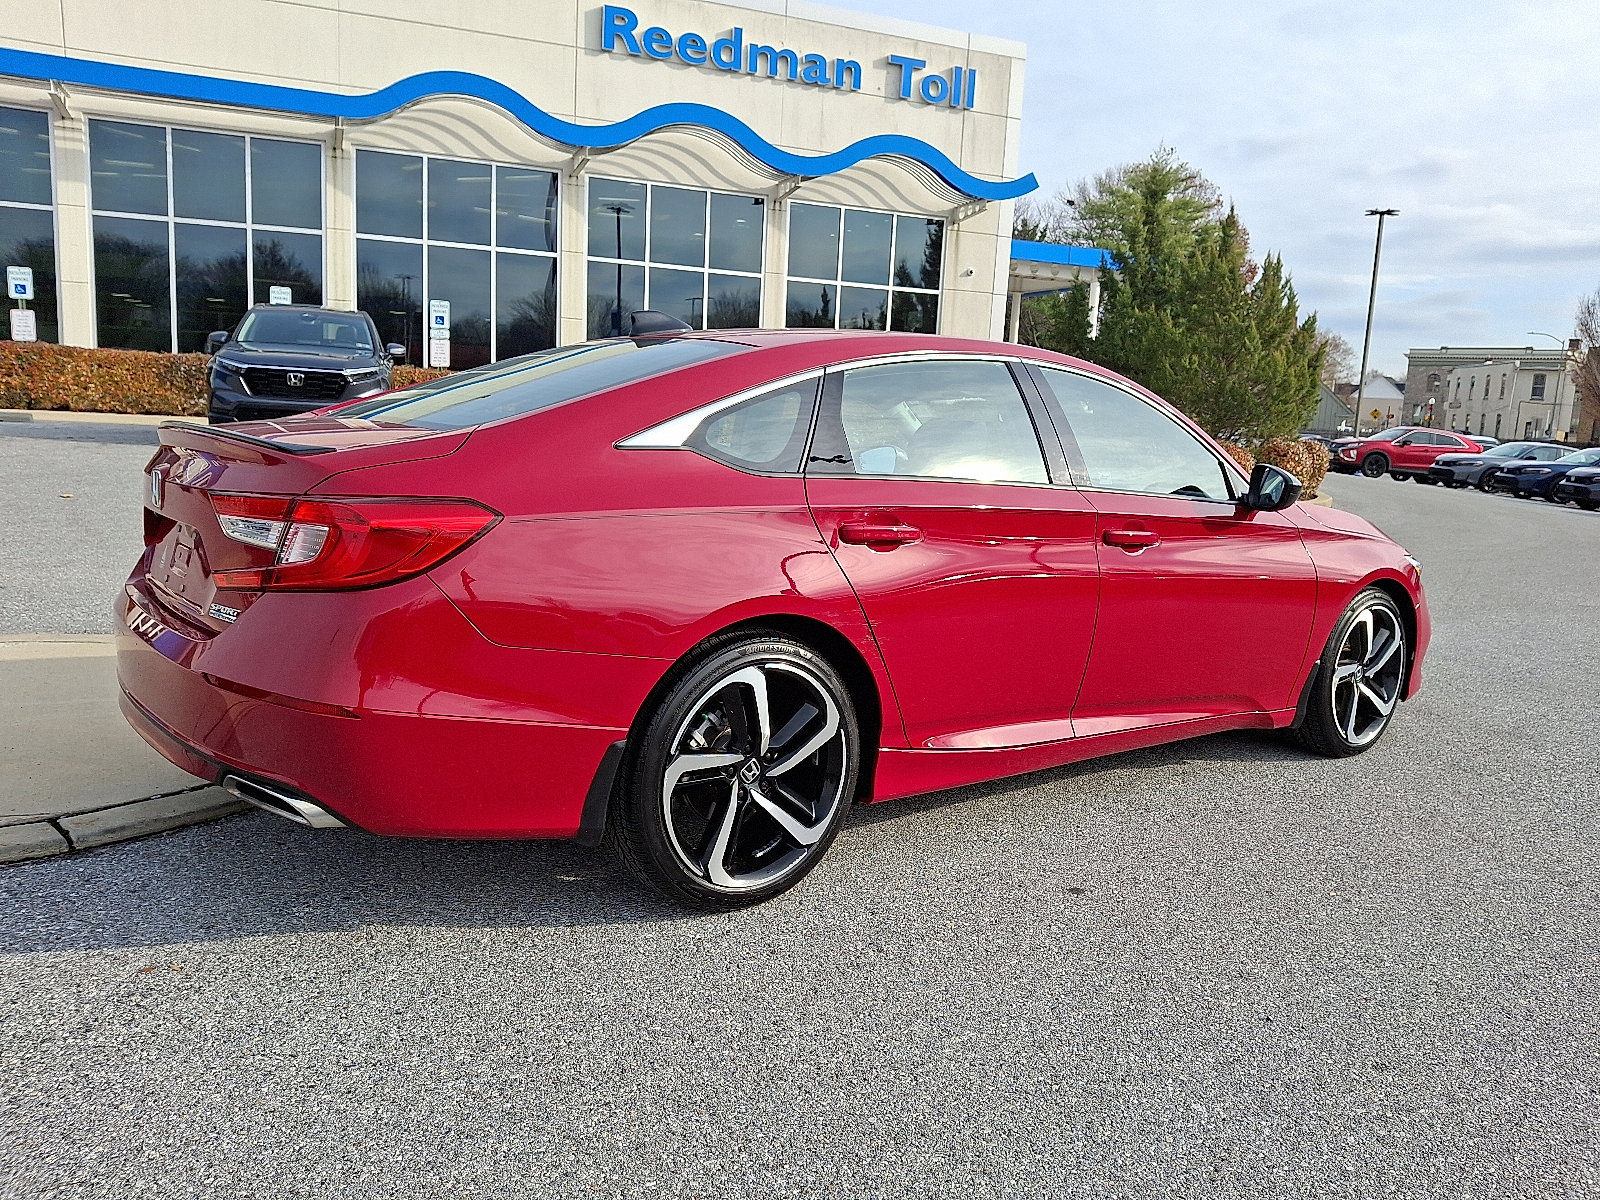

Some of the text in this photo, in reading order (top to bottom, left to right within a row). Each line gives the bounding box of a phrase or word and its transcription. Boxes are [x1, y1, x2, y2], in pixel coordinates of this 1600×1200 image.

[602, 4, 977, 110] Reedman Toll
[210, 603, 241, 616] SPORT
